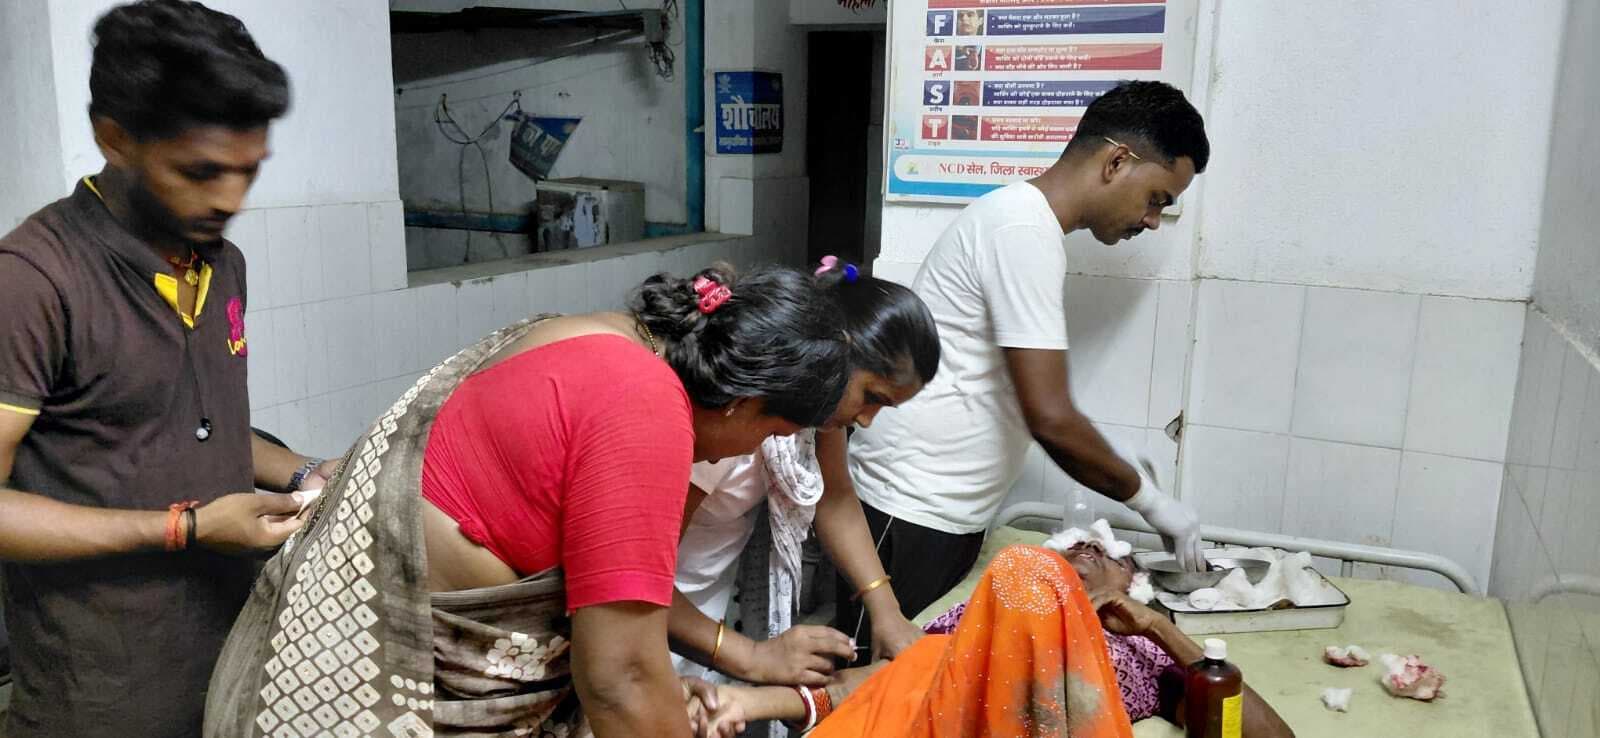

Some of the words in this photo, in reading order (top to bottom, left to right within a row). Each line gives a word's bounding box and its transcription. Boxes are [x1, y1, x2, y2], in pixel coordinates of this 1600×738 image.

[934, 14, 947, 35] F
[929, 48, 947, 69] A
[930, 84, 944, 104] S
[720, 95, 781, 131] शौचालय
[929, 118, 942, 138] T
[939, 162, 965, 174] NCD
[990, 161, 1016, 176] जिला
